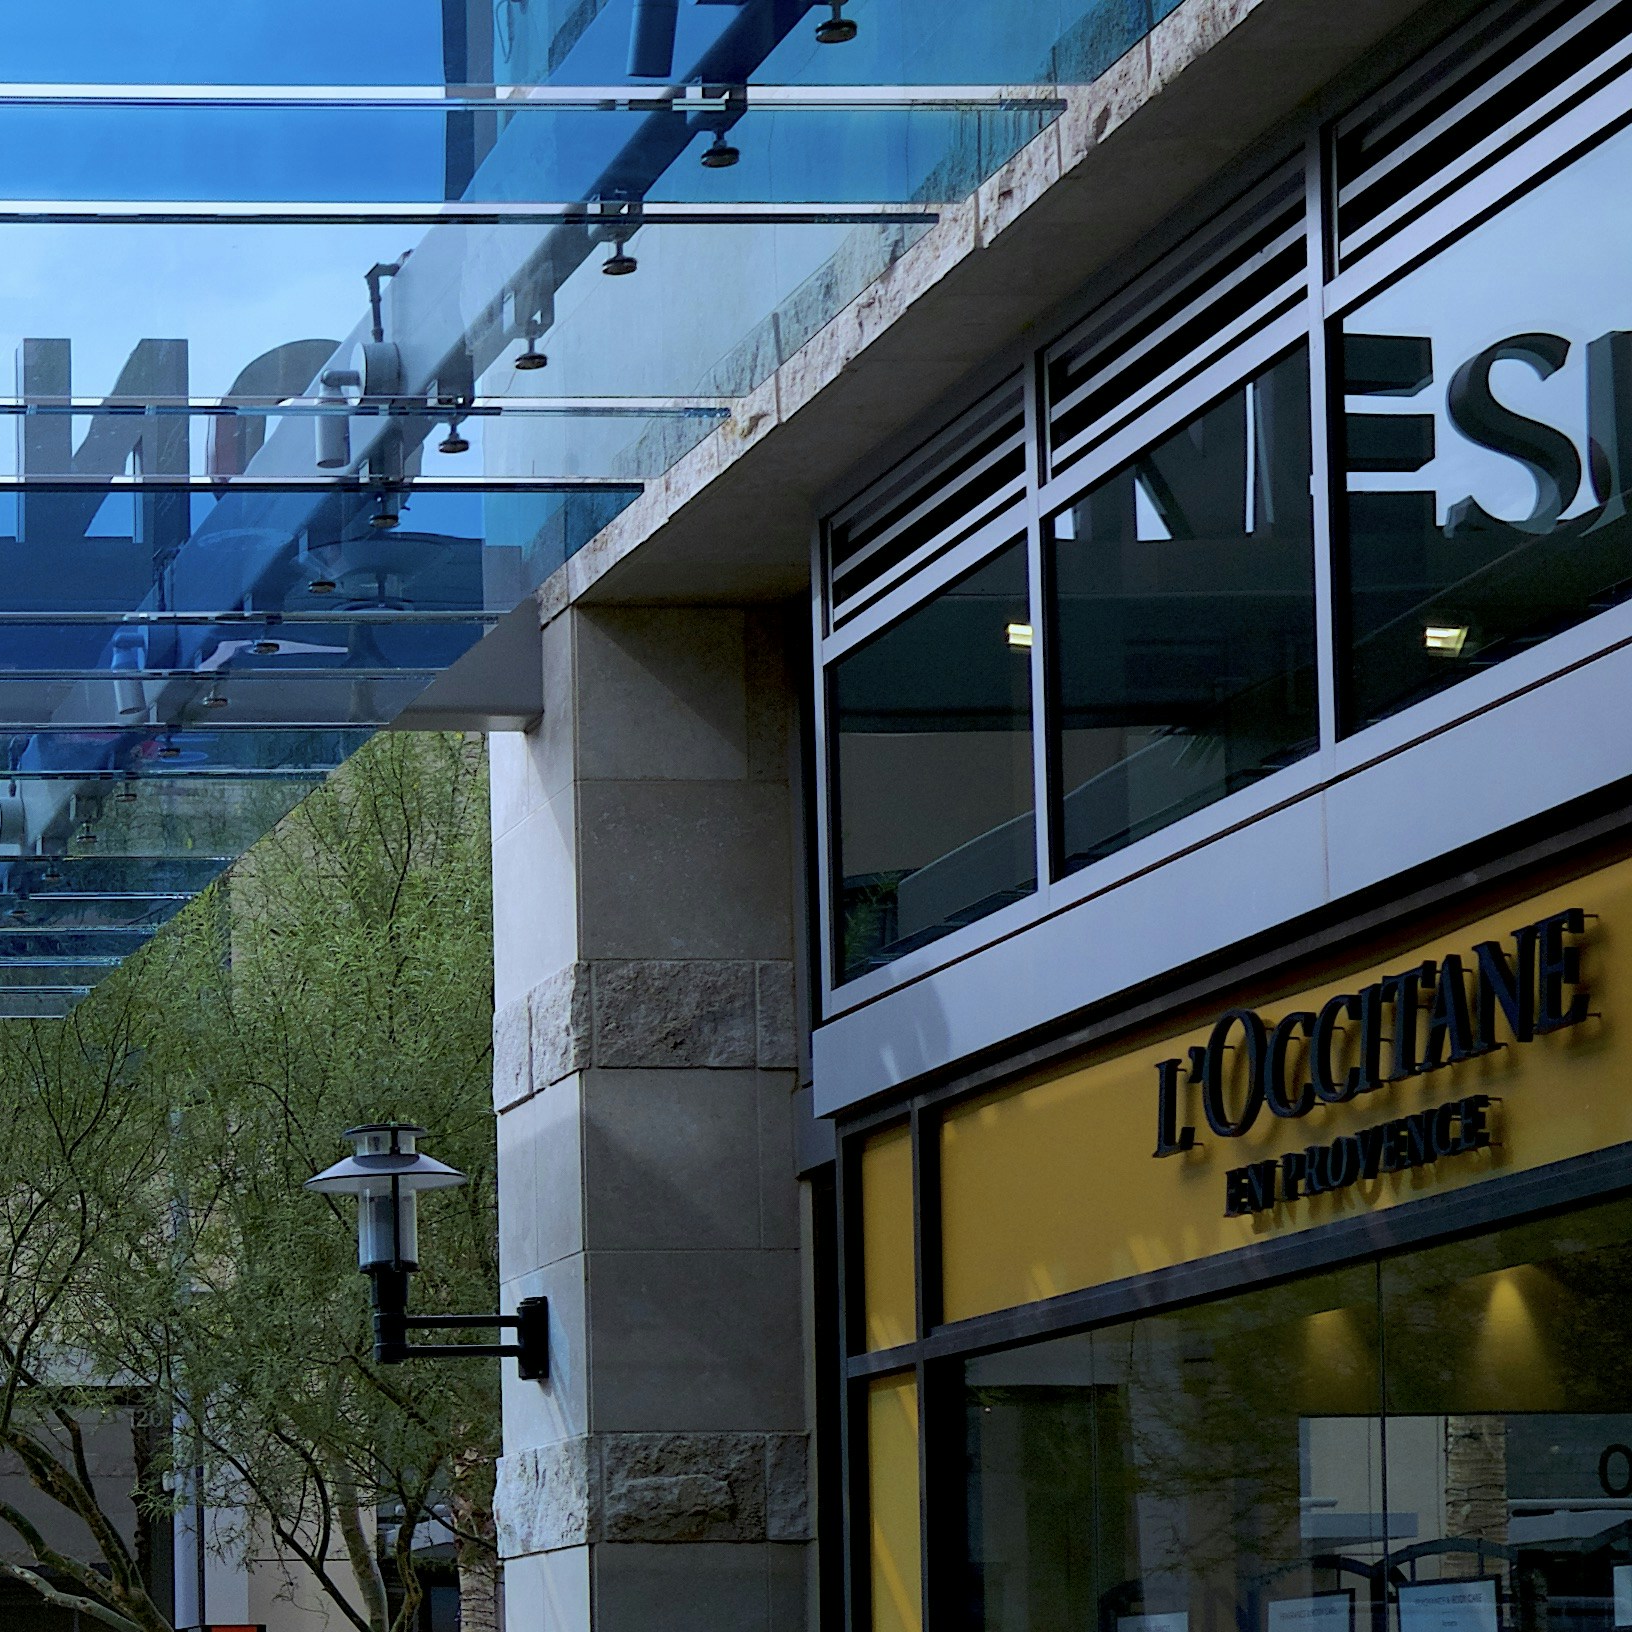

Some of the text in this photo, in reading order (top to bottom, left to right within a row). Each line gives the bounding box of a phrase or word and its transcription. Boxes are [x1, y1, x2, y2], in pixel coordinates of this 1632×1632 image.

[1153, 908, 1593, 1158] L'OCCITANE
[1224, 1094, 1493, 1217] EN PROVENCE
